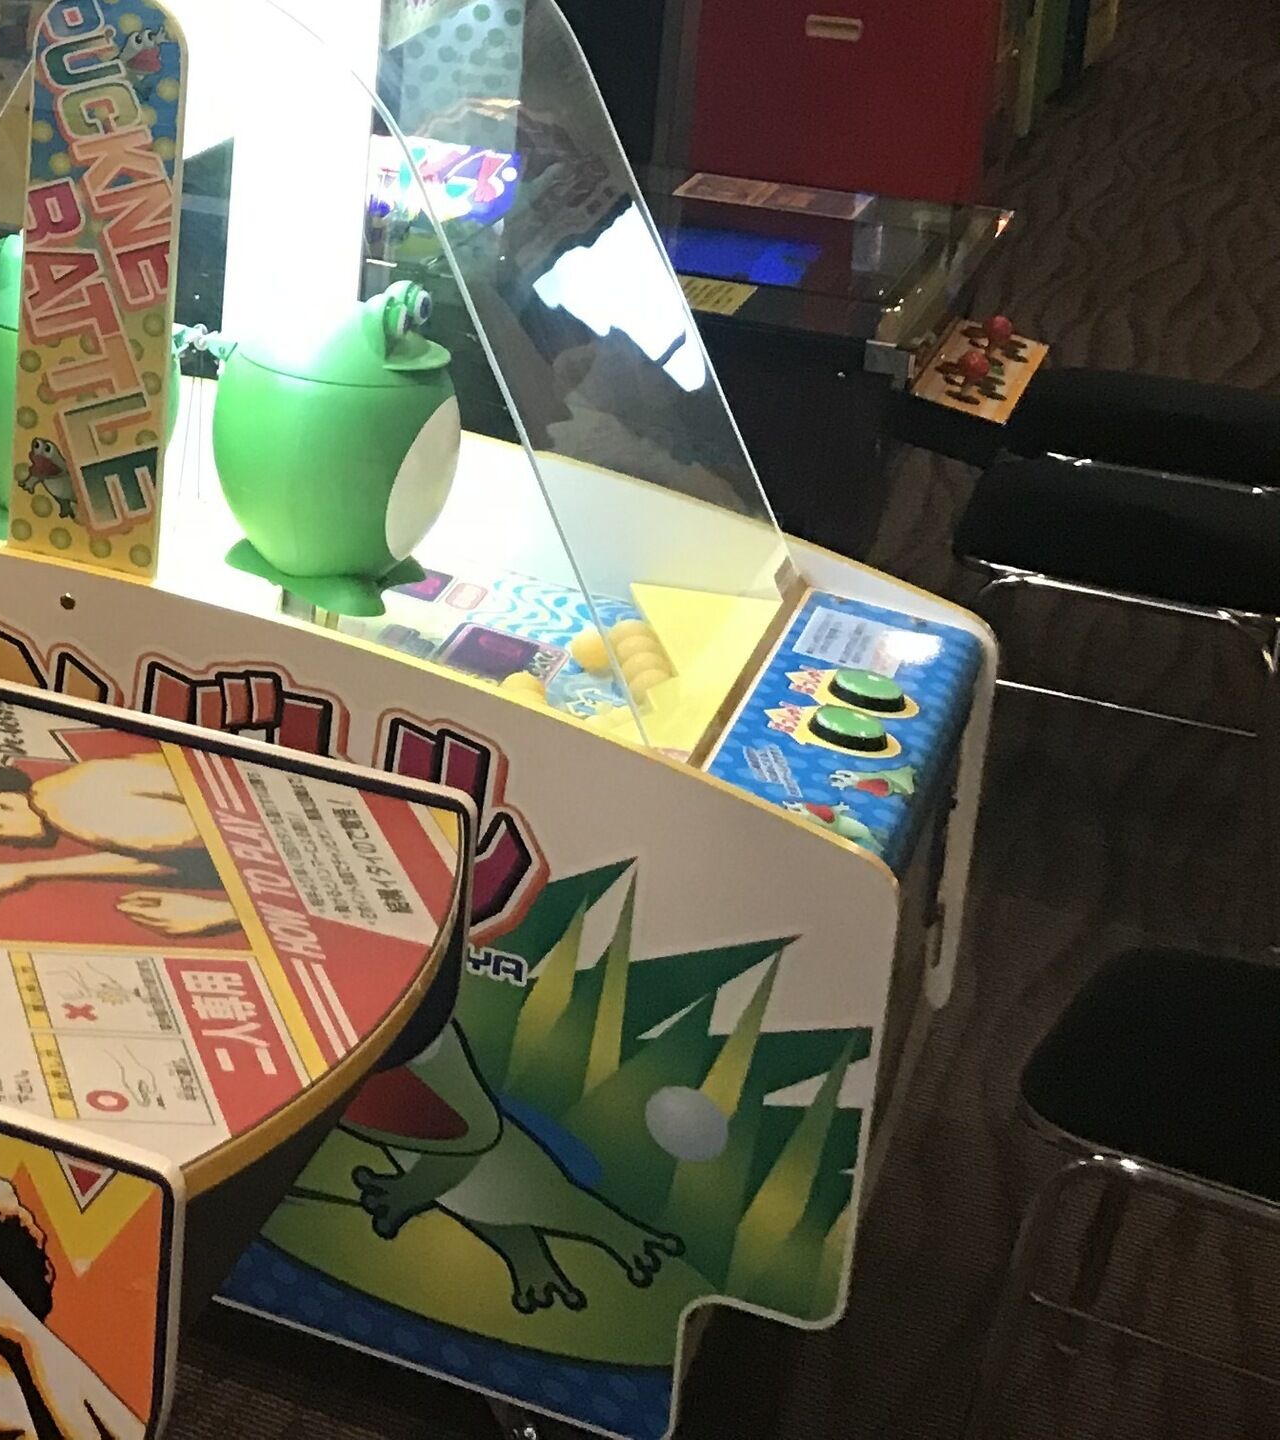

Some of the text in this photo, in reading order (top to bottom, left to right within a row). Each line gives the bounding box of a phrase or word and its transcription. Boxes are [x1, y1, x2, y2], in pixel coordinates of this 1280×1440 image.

[24, 177, 162, 538] BATTLE
[215, 809, 280, 866] PLAY
[241, 866, 297, 899] TO
[256, 900, 327, 961] HOW
[180, 970, 278, 1076] 二人専用
